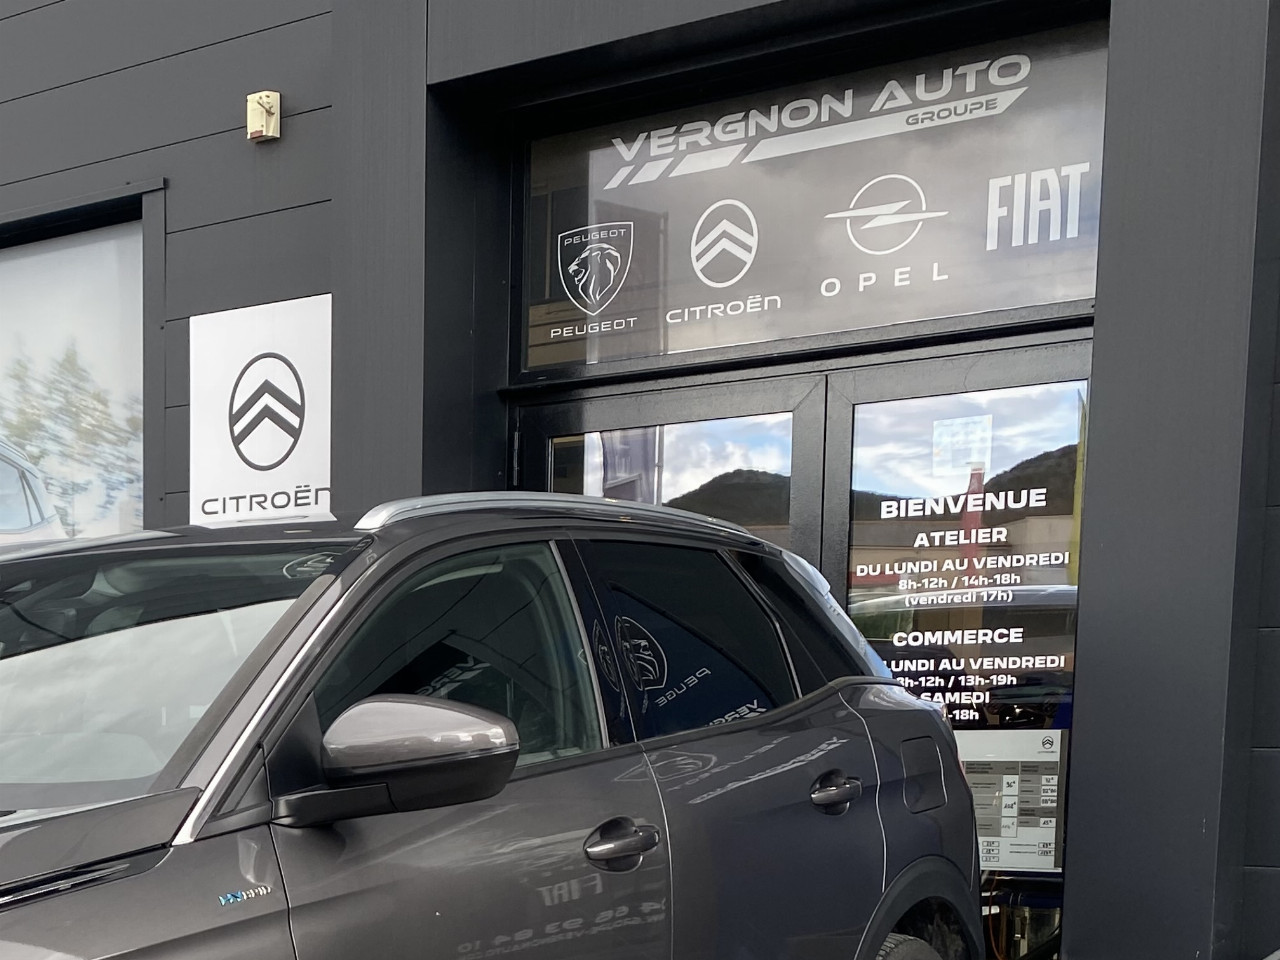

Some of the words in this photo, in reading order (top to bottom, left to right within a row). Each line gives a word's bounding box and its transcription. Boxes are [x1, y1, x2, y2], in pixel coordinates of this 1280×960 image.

[612, 89, 853, 161] VERGNON
[870, 54, 1031, 112] AUTO
[906, 98, 998, 126] GROUPE
[985, 161, 1090, 251] FIAT
[564, 228, 627, 246] PEUGEOT
[820, 262, 949, 297] OPEL
[550, 317, 637, 338] PEUGEOT
[880, 488, 1047, 519] BIENVENUE
[913, 527, 1008, 548] ATELIER
[856, 564, 881, 577] DU
[885, 560, 938, 574] LUNDI
[941, 557, 968, 571] AU
[972, 551, 1069, 569] VENDREDI
[898, 577, 948, 590] 8h-12h
[951, 577, 958, 589] /
[961, 572, 1021, 587] 14h-18h
[905, 590, 977, 607] (vendredi
[980, 589, 1013, 603] 17h)
[892, 627, 1024, 647] COMMERCE
[938, 658, 965, 671] AU
[969, 655, 1065, 670] VENDREDI
[947, 675, 954, 688] /
[958, 674, 1017, 687] 13h-19h
[920, 691, 990, 704] SAMEDI
